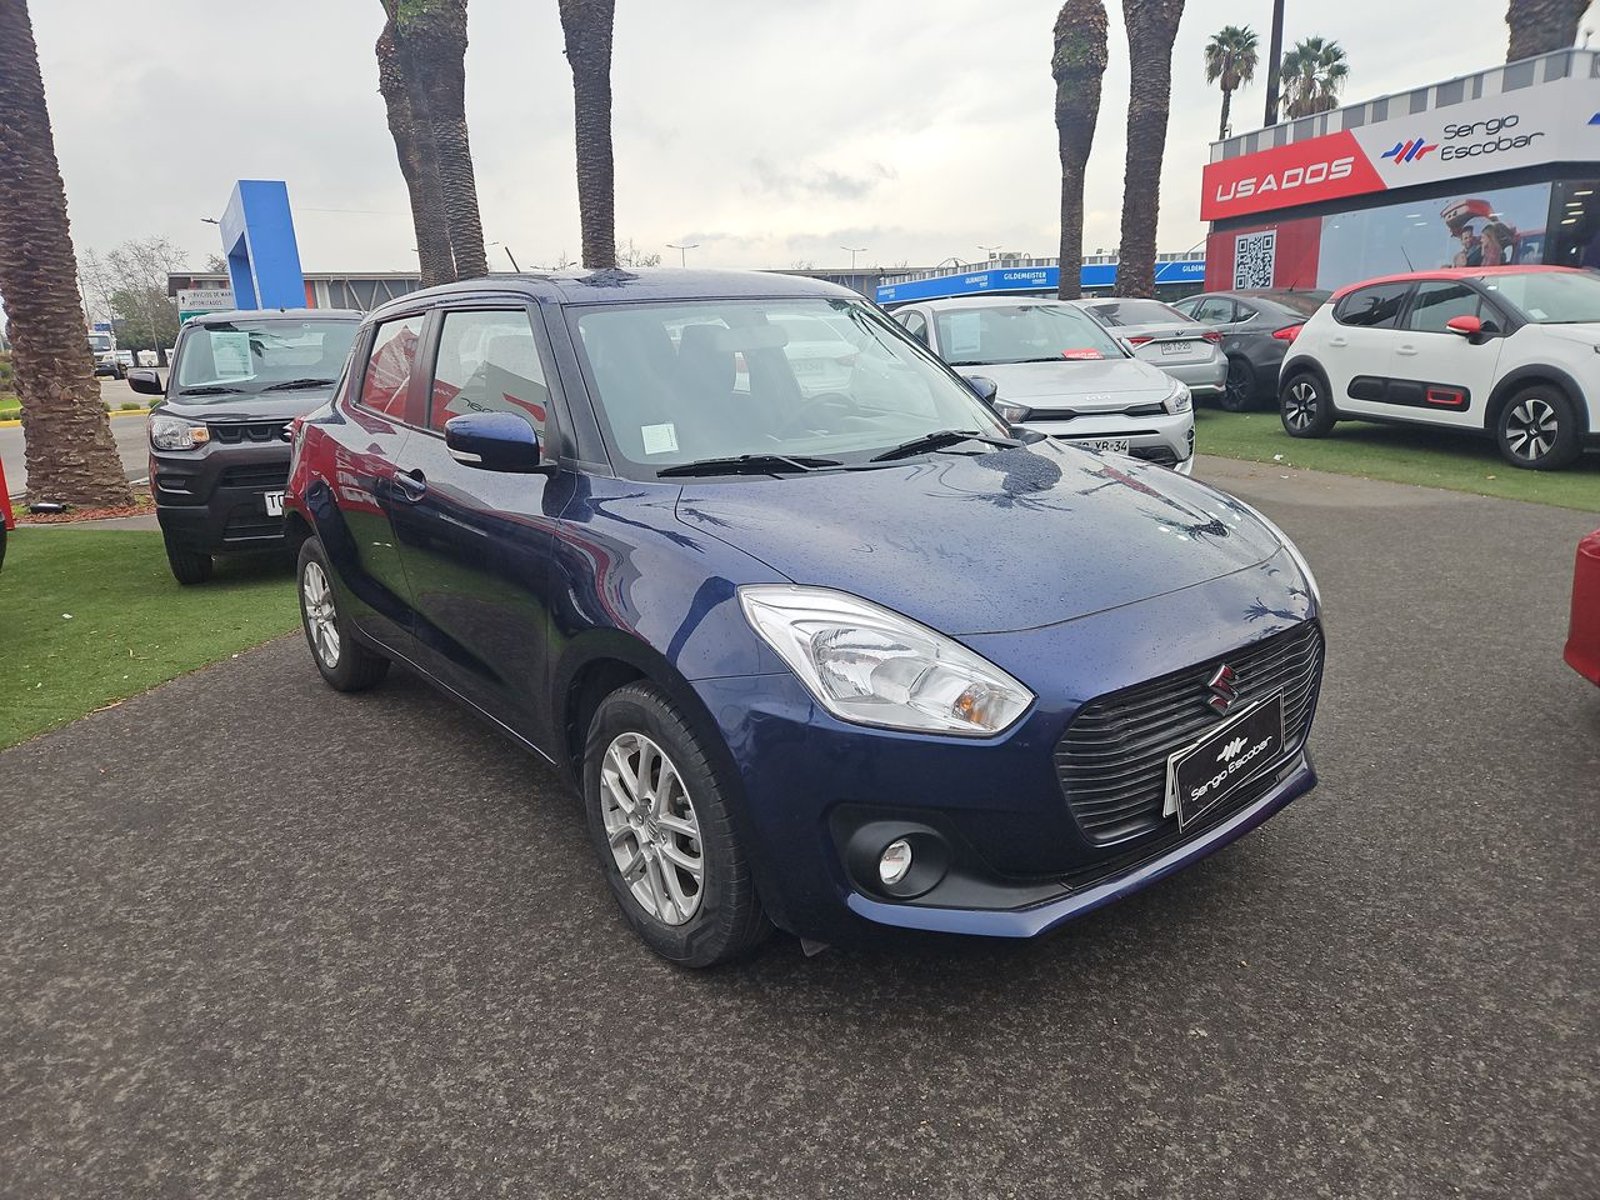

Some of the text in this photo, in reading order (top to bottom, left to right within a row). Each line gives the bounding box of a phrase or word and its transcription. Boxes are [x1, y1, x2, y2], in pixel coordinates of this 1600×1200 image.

[1443, 114, 1519, 140] Sergio
[1440, 132, 1545, 161] Escobar
[1216, 156, 1355, 202] USADOS
[1004, 271, 1047, 280] GILDEMEISTER
[1182, 264, 1205, 272] GILDEM
[1228, 735, 1273, 774] Escobar
